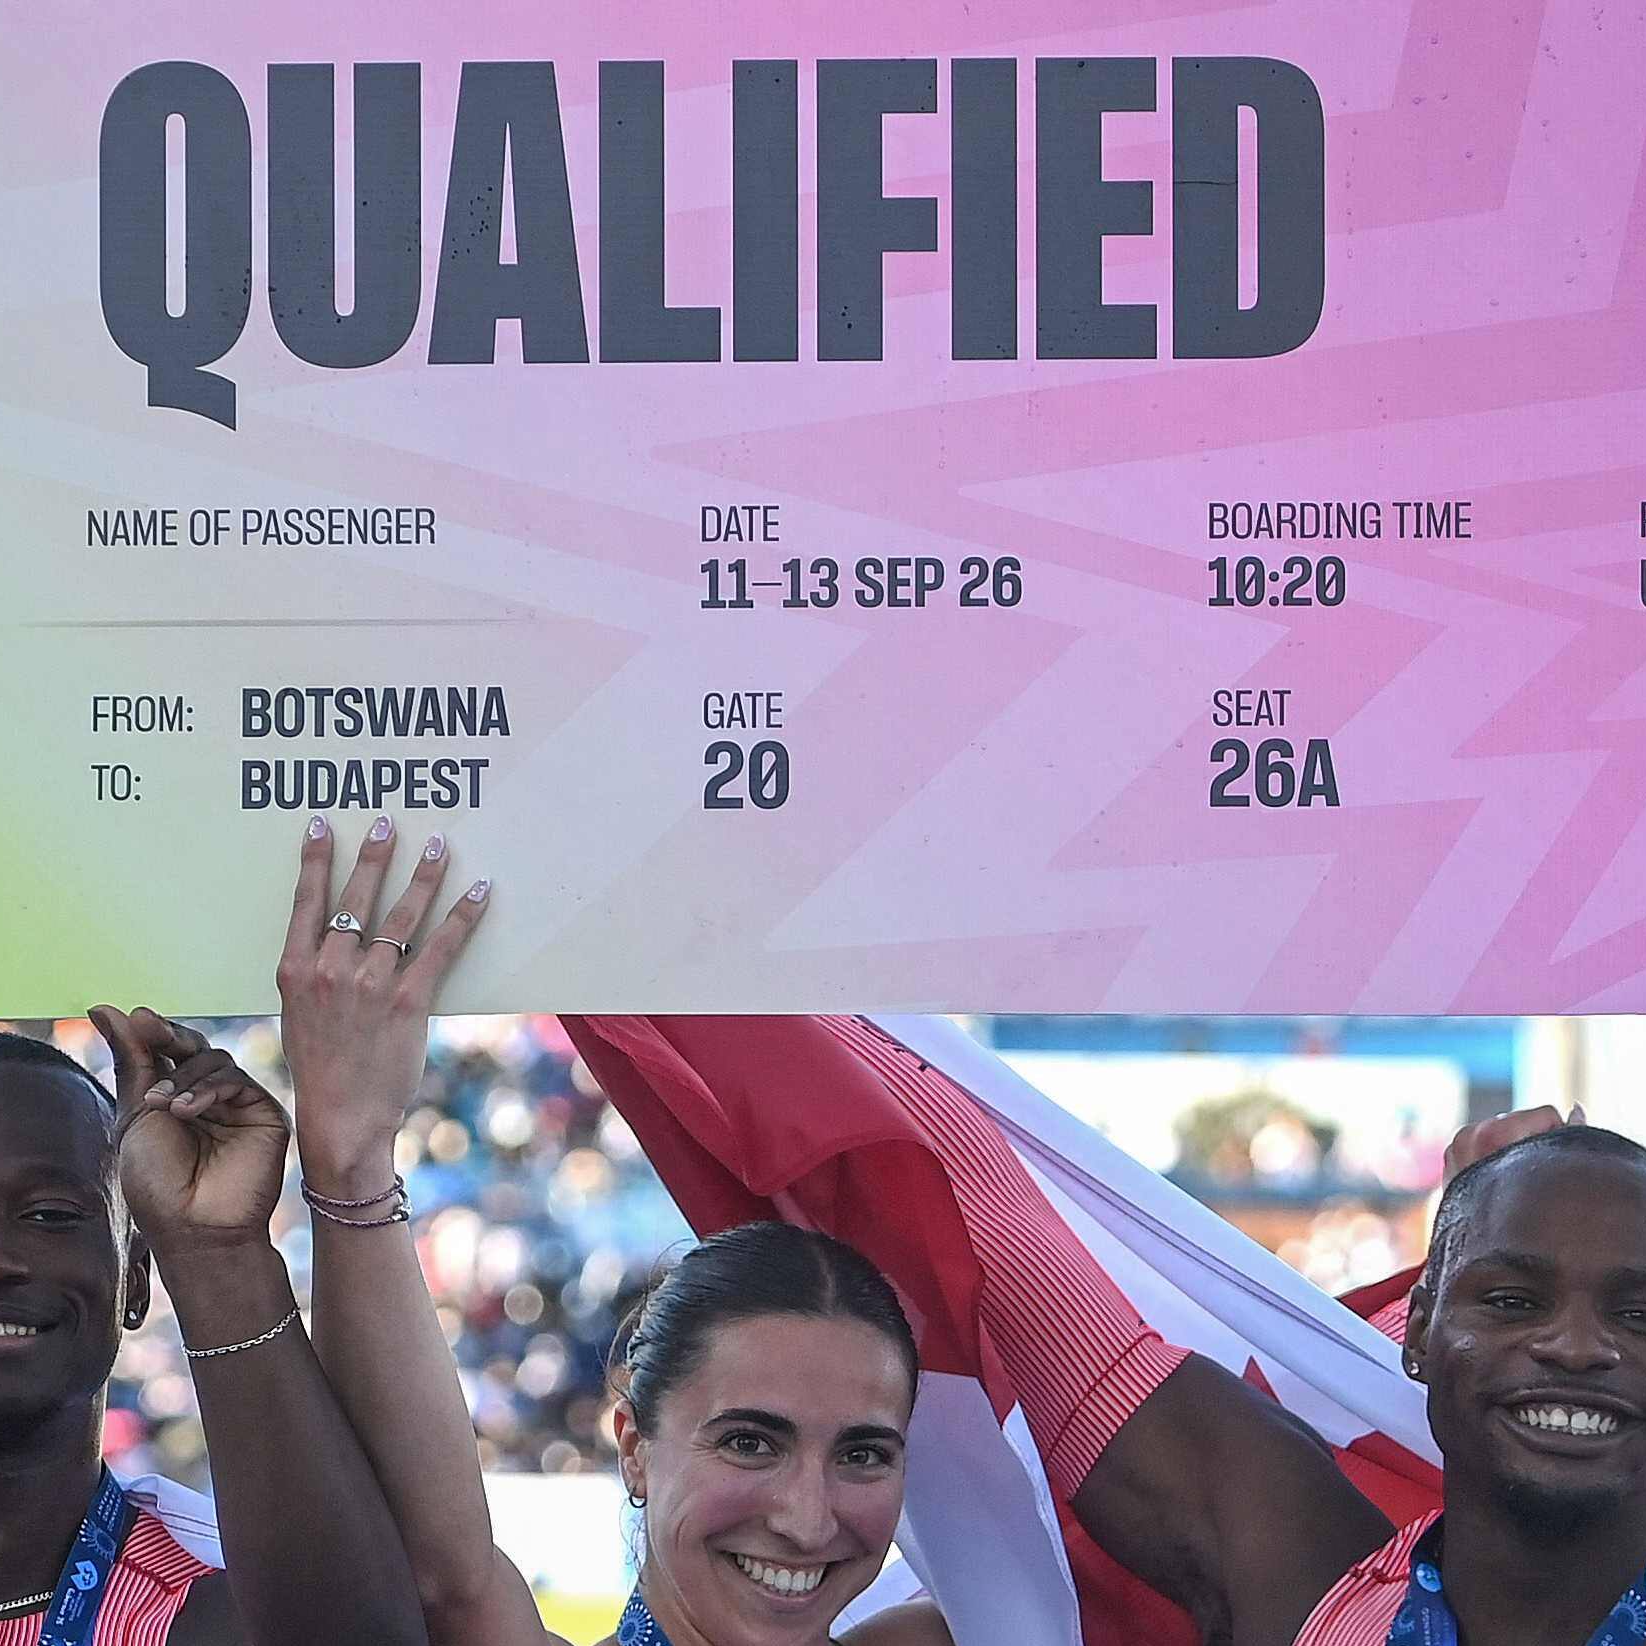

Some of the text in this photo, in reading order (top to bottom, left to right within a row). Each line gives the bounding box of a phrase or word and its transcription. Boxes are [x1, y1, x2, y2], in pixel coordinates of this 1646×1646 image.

[100, 57, 1325, 431] QUALIFIED
[88, 509, 435, 546] NAME OF PASSENGER
[702, 506, 779, 542] DATE
[1209, 502, 1471, 539] BOARDING TIME
[855, 558, 944, 608] SEP
[960, 557, 1022, 607] 26
[1209, 556, 1345, 607] 10:20
[93, 687, 510, 737] FROM: BOTSWANA
[704, 693, 782, 729] GATE
[1213, 690, 1291, 726] SEAT
[91, 759, 489, 809] TO: BUDAPEST
[704, 741, 789, 809] 20
[1210, 739, 1340, 807] 26A
